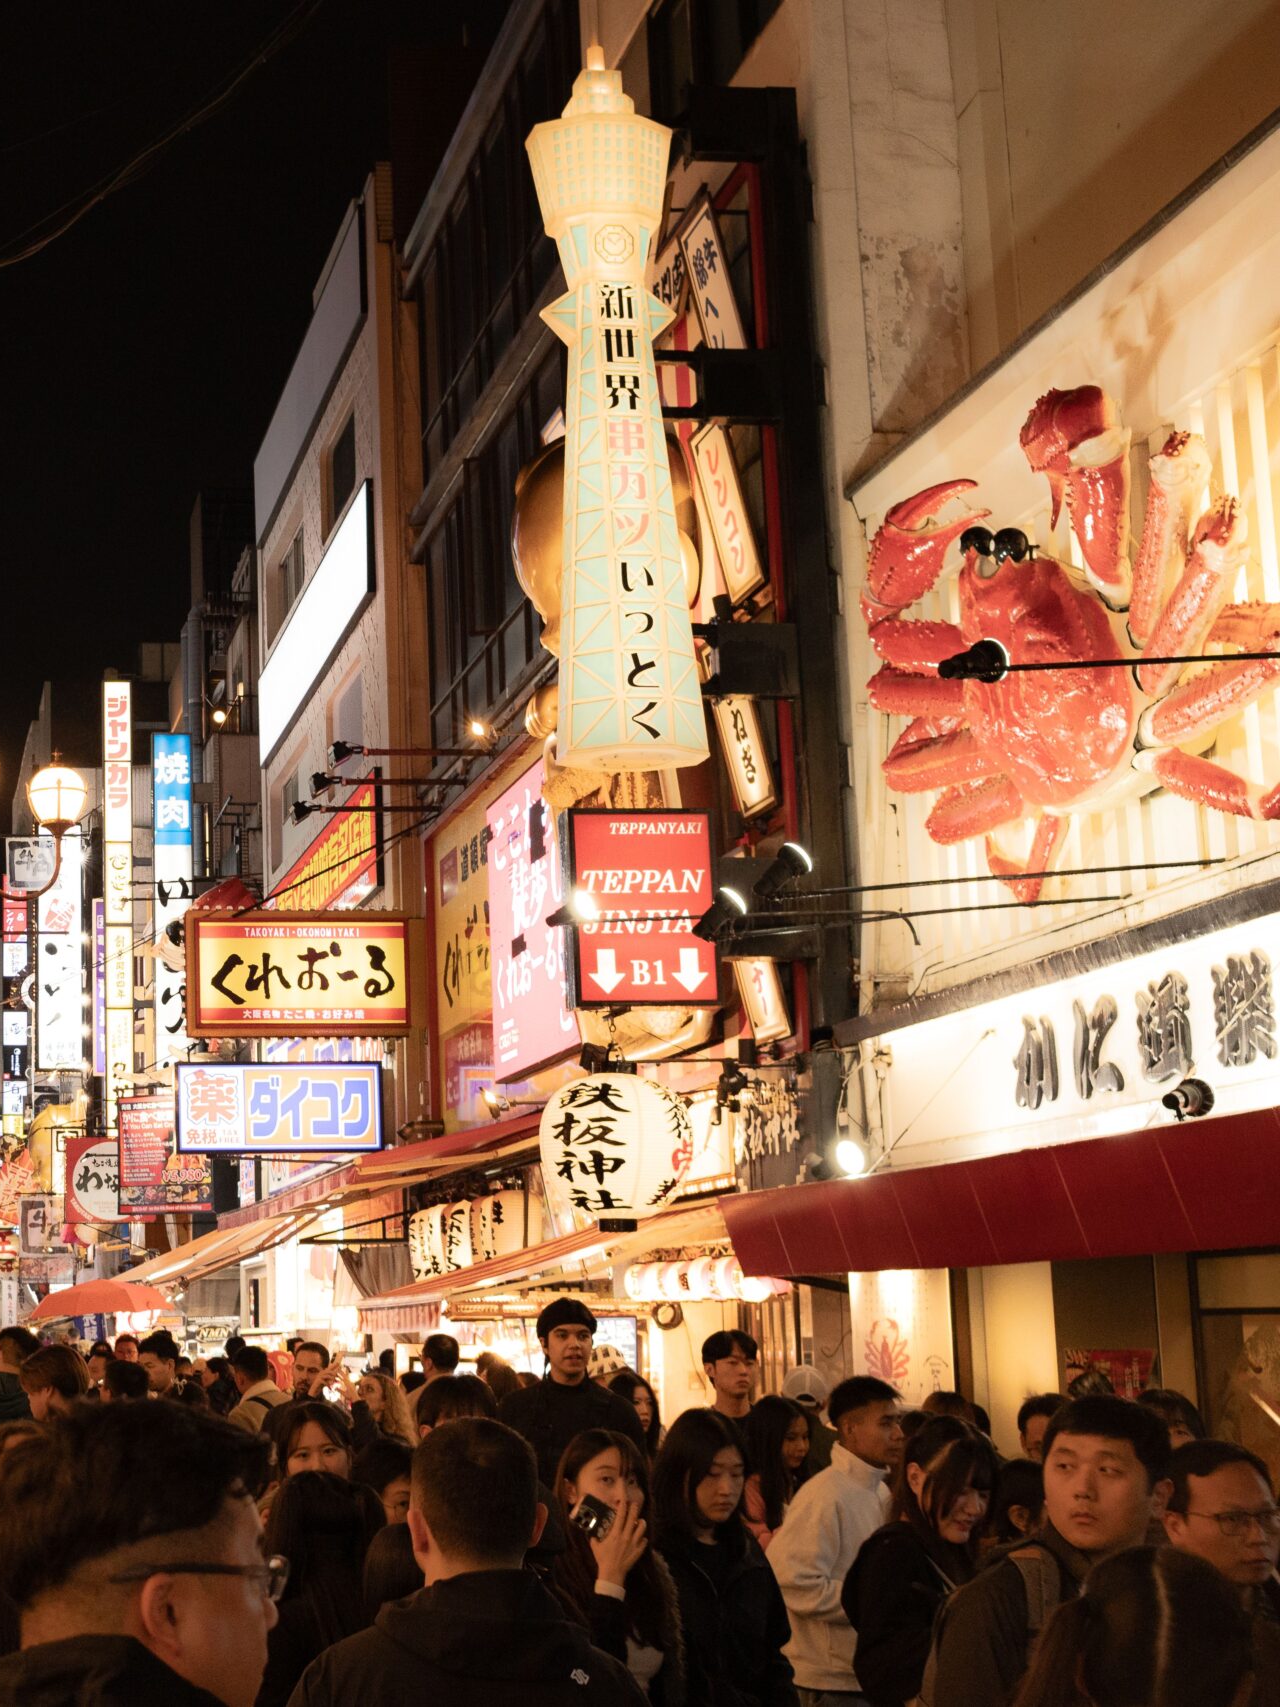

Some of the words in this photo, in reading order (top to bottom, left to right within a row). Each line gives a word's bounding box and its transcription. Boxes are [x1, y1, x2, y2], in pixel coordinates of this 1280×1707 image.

[107, 696, 129, 809] ジャンカラ
[154, 751, 190, 829] 焼肉
[610, 822, 702, 835] TEPPANYAKI
[582, 868, 705, 895] TEPPAN
[582, 908, 694, 935] JINJYA
[211, 941, 396, 1006] くれおーる
[630, 960, 667, 986] B1
[187, 1067, 238, 1125] 薬
[250, 1077, 370, 1138] ダイコク
[186, 1129, 219, 1144] 免税
[553, 1081, 633, 1213] 鉄板神社
[198, 1326, 230, 1339] NMN
